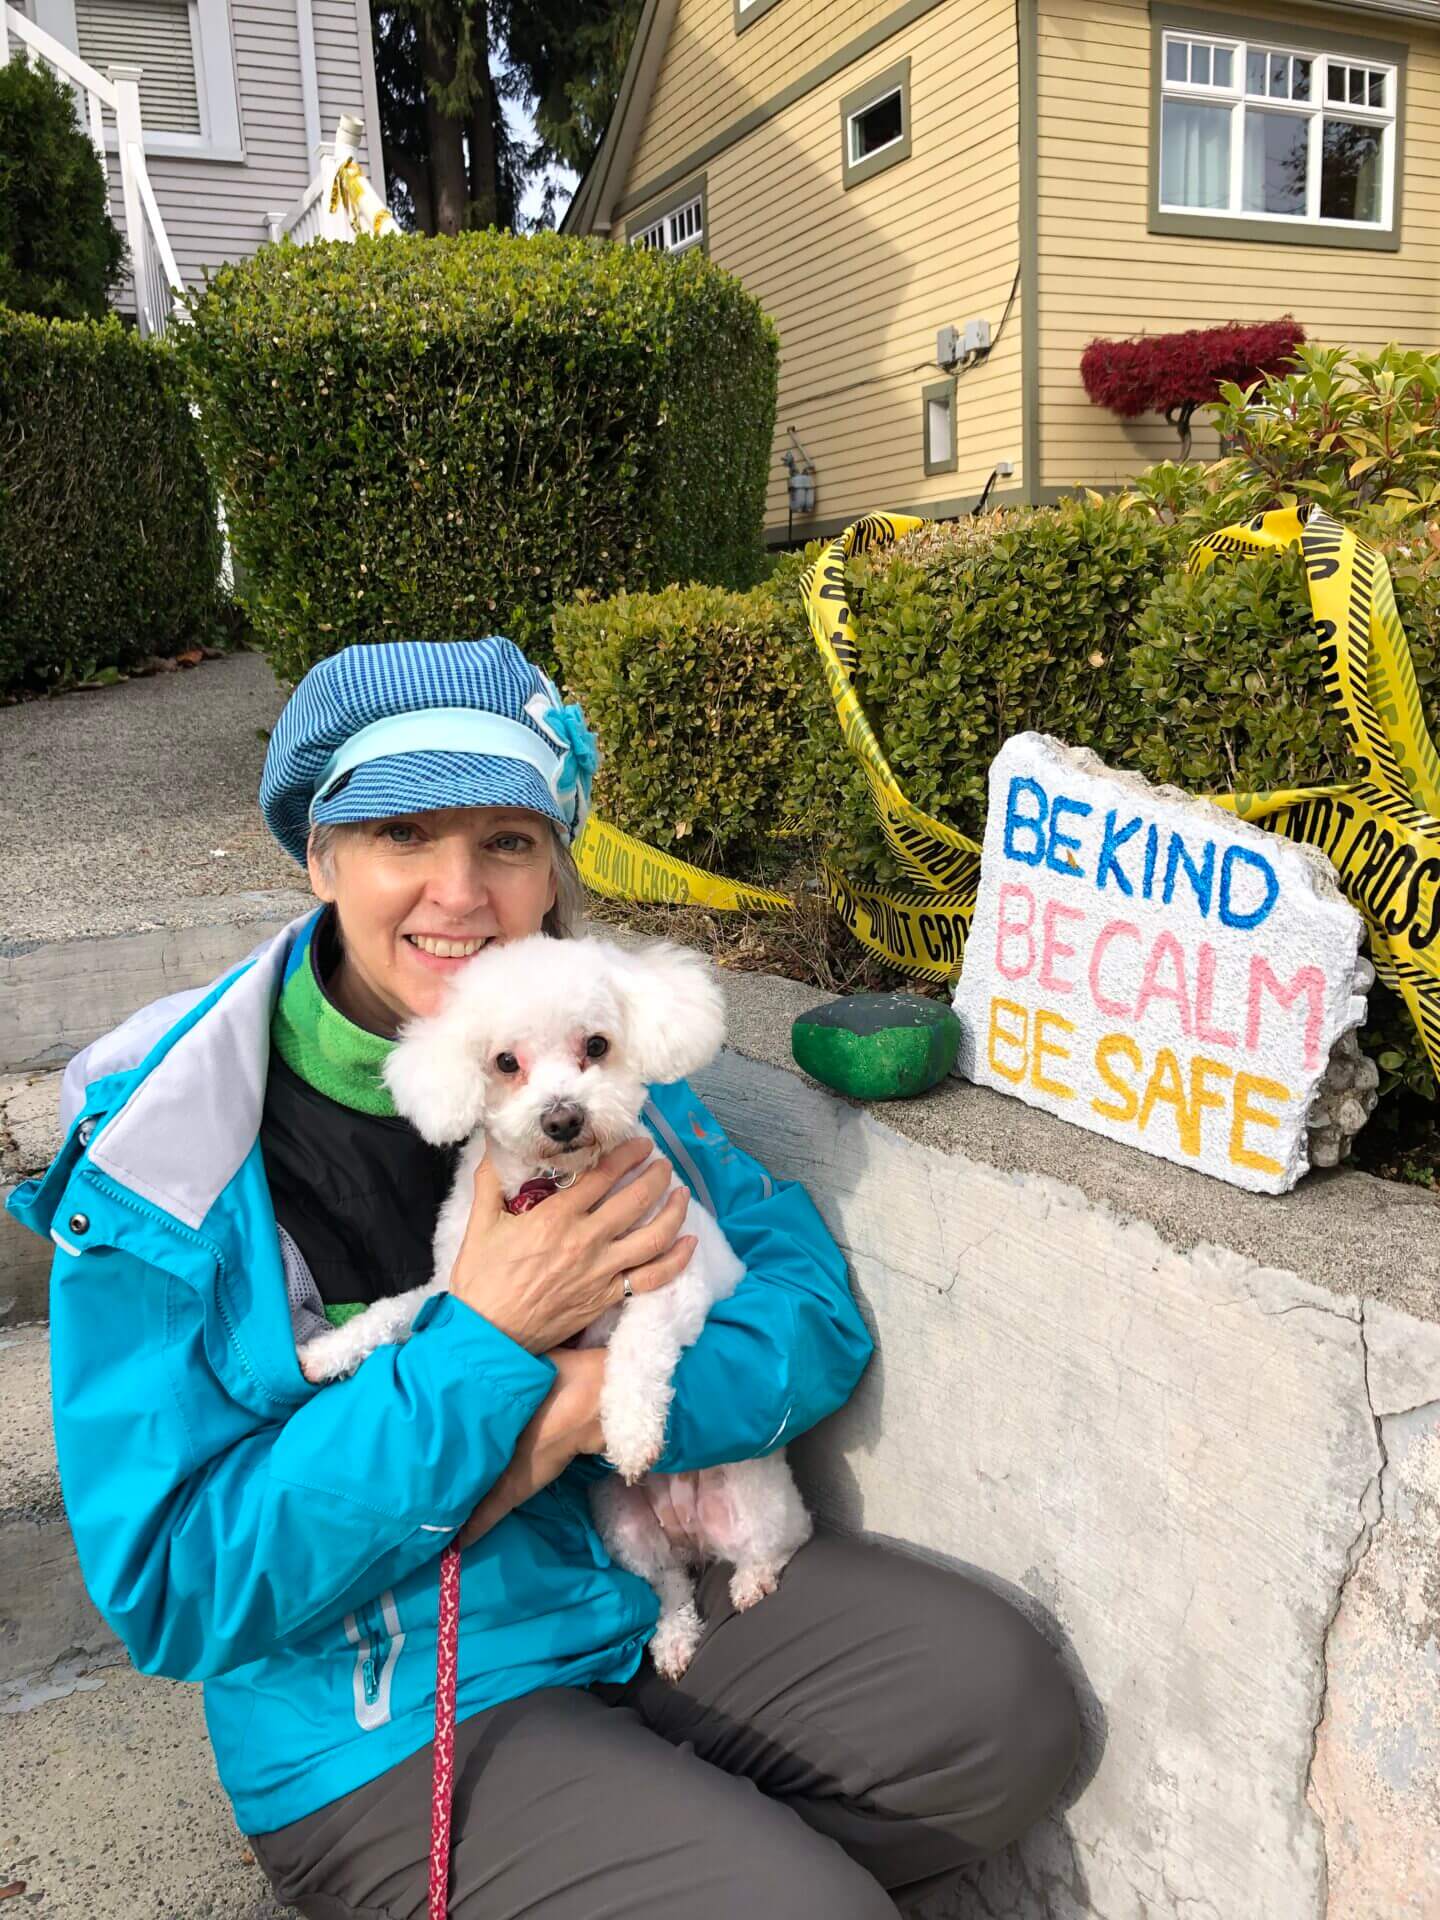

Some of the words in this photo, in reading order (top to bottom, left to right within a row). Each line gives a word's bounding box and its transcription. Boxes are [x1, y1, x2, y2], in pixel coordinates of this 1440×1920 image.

[888, 810, 981, 895] WARNI
[1004, 776, 1092, 879] BE
[1097, 808, 1280, 930] KIND
[918, 913, 975, 964] CRO
[995, 883, 1085, 993] BE
[1088, 919, 1326, 1071] CALM
[988, 996, 1080, 1100] BE
[1090, 1033, 1290, 1176] SAFE
